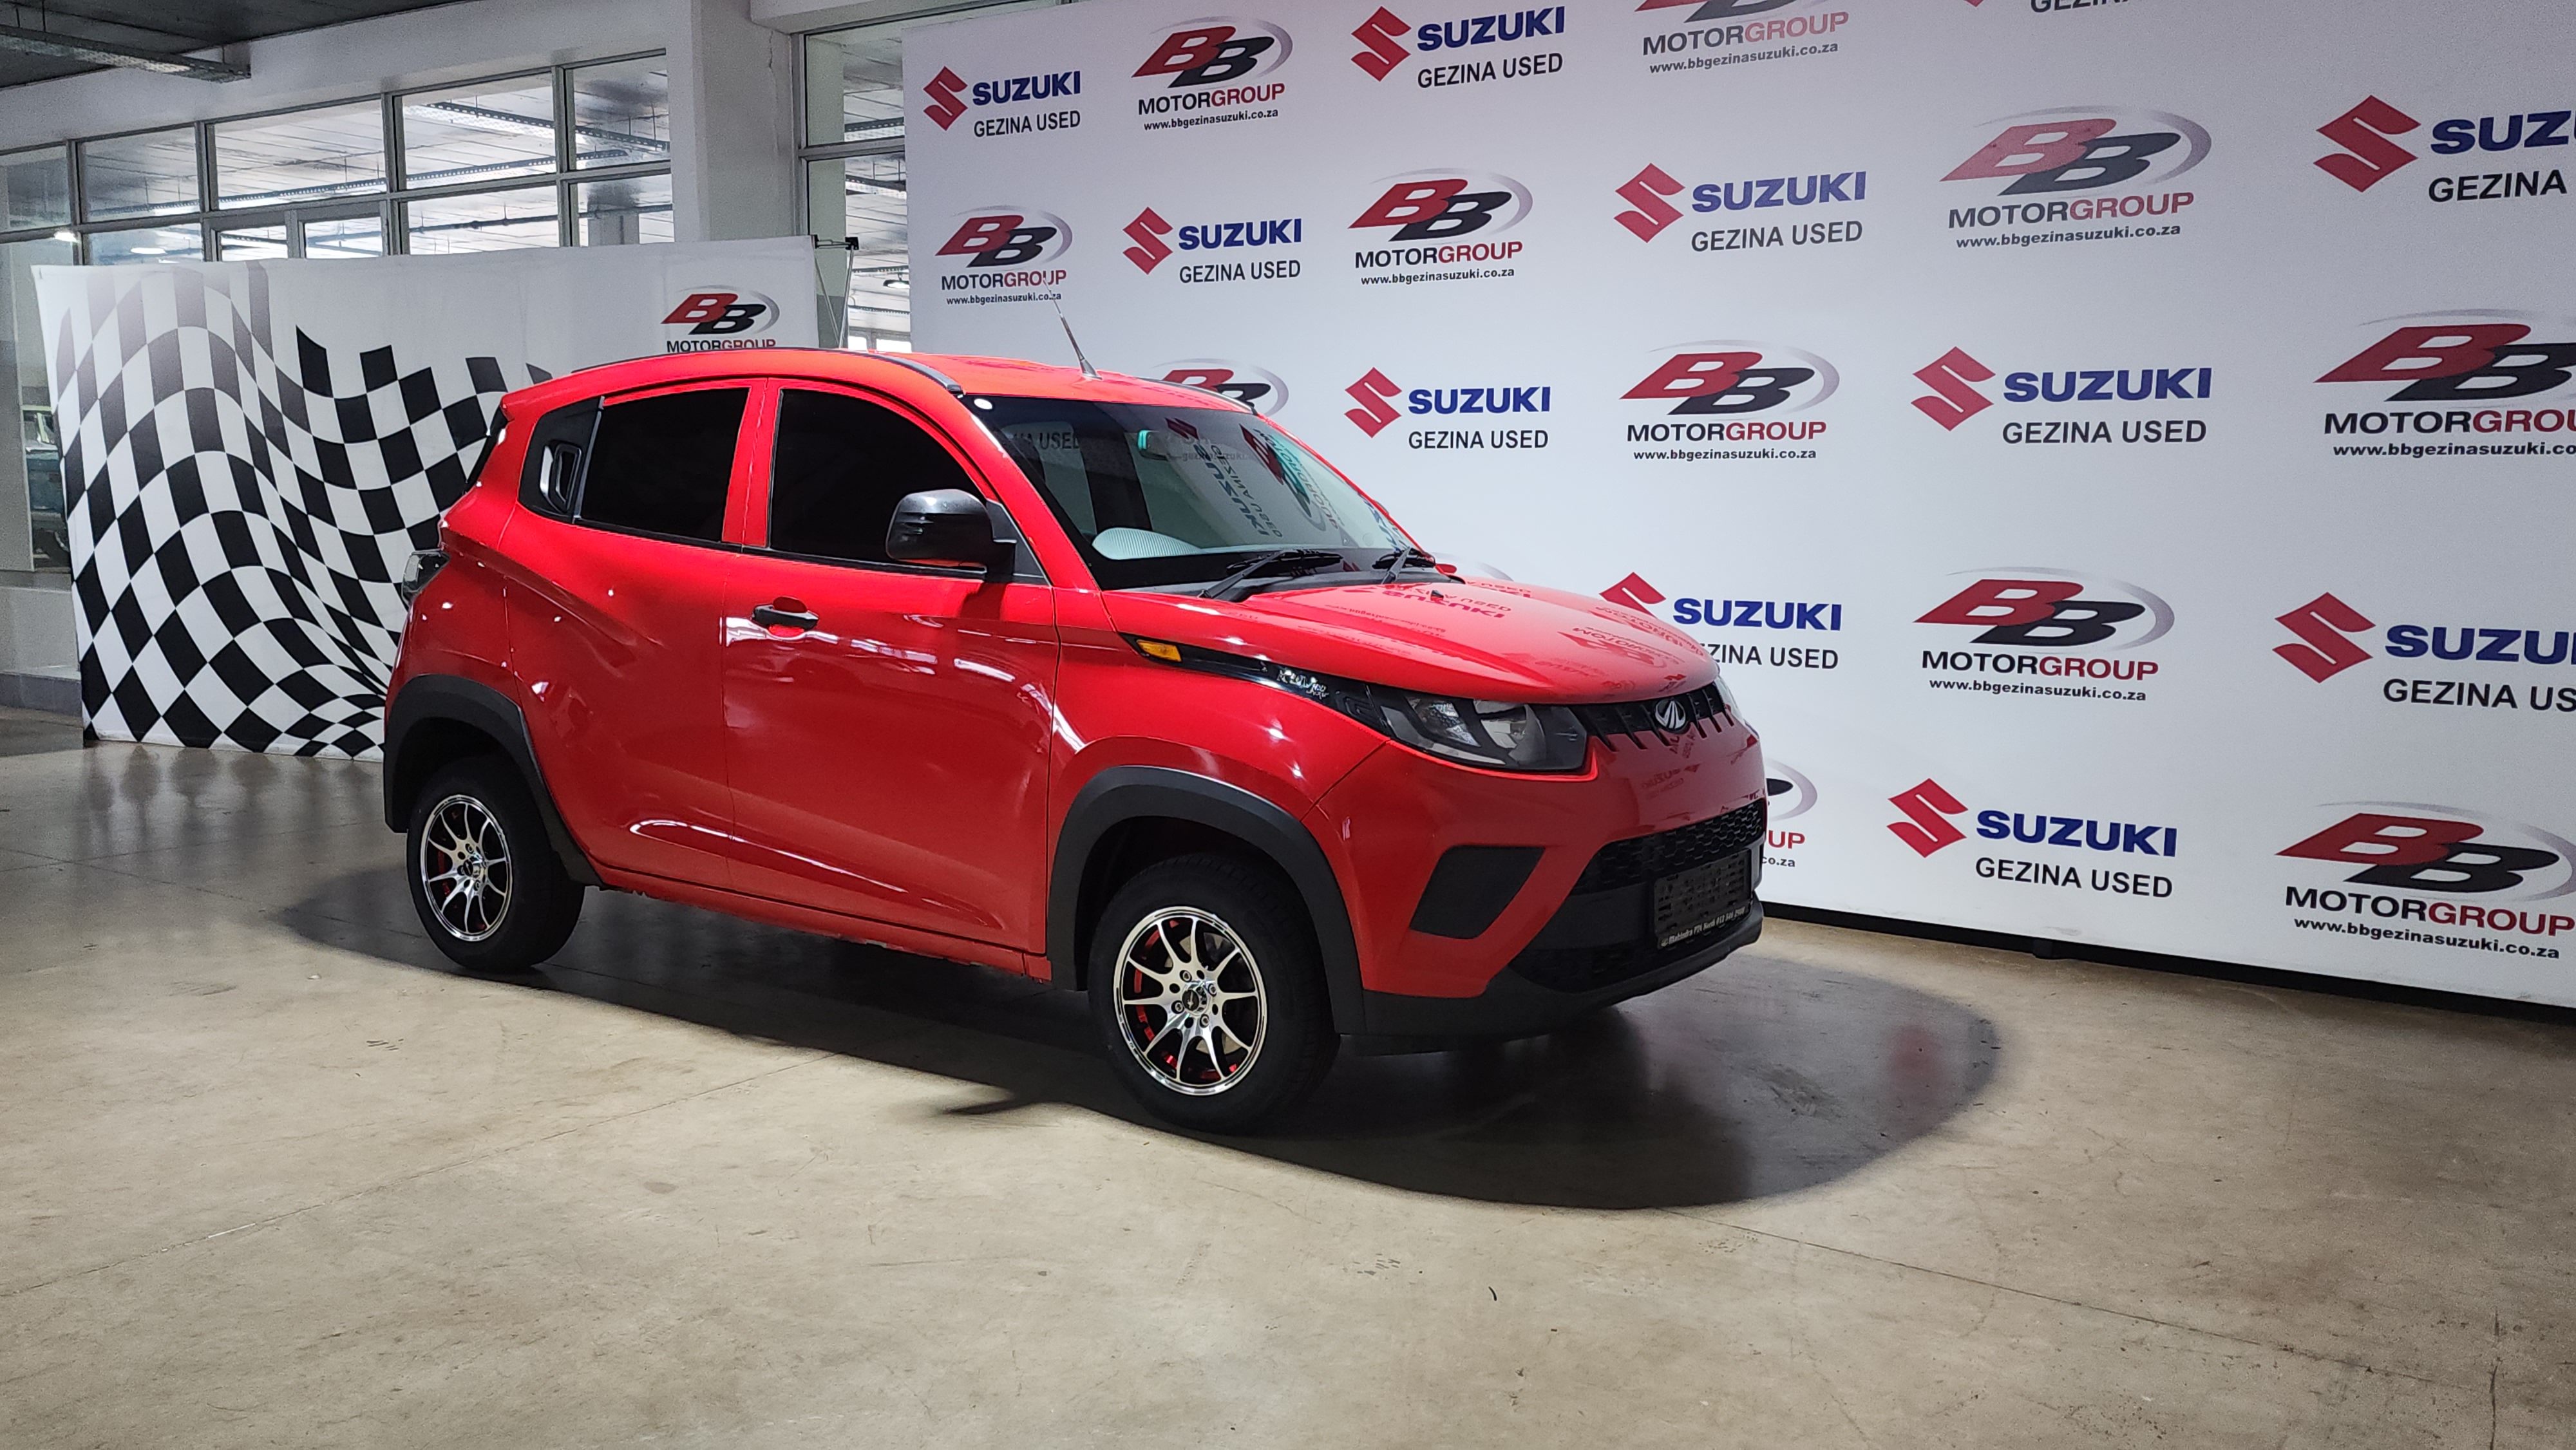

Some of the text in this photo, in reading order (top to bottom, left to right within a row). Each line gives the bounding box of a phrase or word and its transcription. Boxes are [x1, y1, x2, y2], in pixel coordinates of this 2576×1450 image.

[1417, 6, 1565, 52] SUZUKI
[1642, 11, 1849, 55] MOTORGROUP
[1417, 53, 1564, 89] GEZINA USED
[1650, 42, 1838, 73] www.bbgezinasuzuki.co.za
[972, 71, 1081, 106] SUZUKI
[1138, 83, 1285, 116] MOTORGROUP
[974, 110, 1080, 138] GEZINA USED
[1144, 108, 1278, 131] www.bbgezinasuzuki.co.za
[2430, 110, 2576, 155] SUZ
[1691, 171, 1867, 213] SUZUKI
[2428, 169, 2567, 203] GEZINA
[1948, 192, 2194, 229] MOTORGROUP
[1179, 218, 1302, 250] SUZUKI
[1691, 220, 1862, 252] GEZINA USED
[1956, 223, 2181, 249] www.bbgezinasuzuki.co.za
[1355, 241, 1523, 268] MOTORGROUP
[942, 269, 1067, 290] MOTORGROUP
[1179, 259, 1301, 284] GEZINA USED
[1361, 267, 1514, 286] www.bbgezinasuzuki.co.za
[1408, 386, 1550, 415] SUZUKI
[2003, 368, 2211, 402] SUZUKI
[1627, 421, 1826, 442] MOTORGROUP
[2003, 420, 2206, 444] GEZINA USED
[2324, 410, 2576, 434] MOTORGRO
[1408, 430, 1548, 449] GEZINA USED
[1634, 448, 1816, 461] www.bbgezinasuzuki.co.za
[2333, 442, 2576, 458] www.bbgezinasuzuki.co
[1673, 598, 1842, 631] SUZUKI
[1700, 644, 1839, 669] ZINA USED
[2385, 625, 2576, 664] SUZU
[1922, 650, 2159, 681] MOTORGROUP
[1929, 680, 2145, 701] www.bbgezinasuzuki.co.za
[2383, 679, 2576, 712] GEZINA US
[1976, 810, 2177, 857] SUZUKI
[1976, 857, 2173, 898] GEZINA USED
[2286, 886, 2576, 936] MOTORGROUP
[2295, 918, 2559, 959] www.bbgezinasuzuki.co.za
